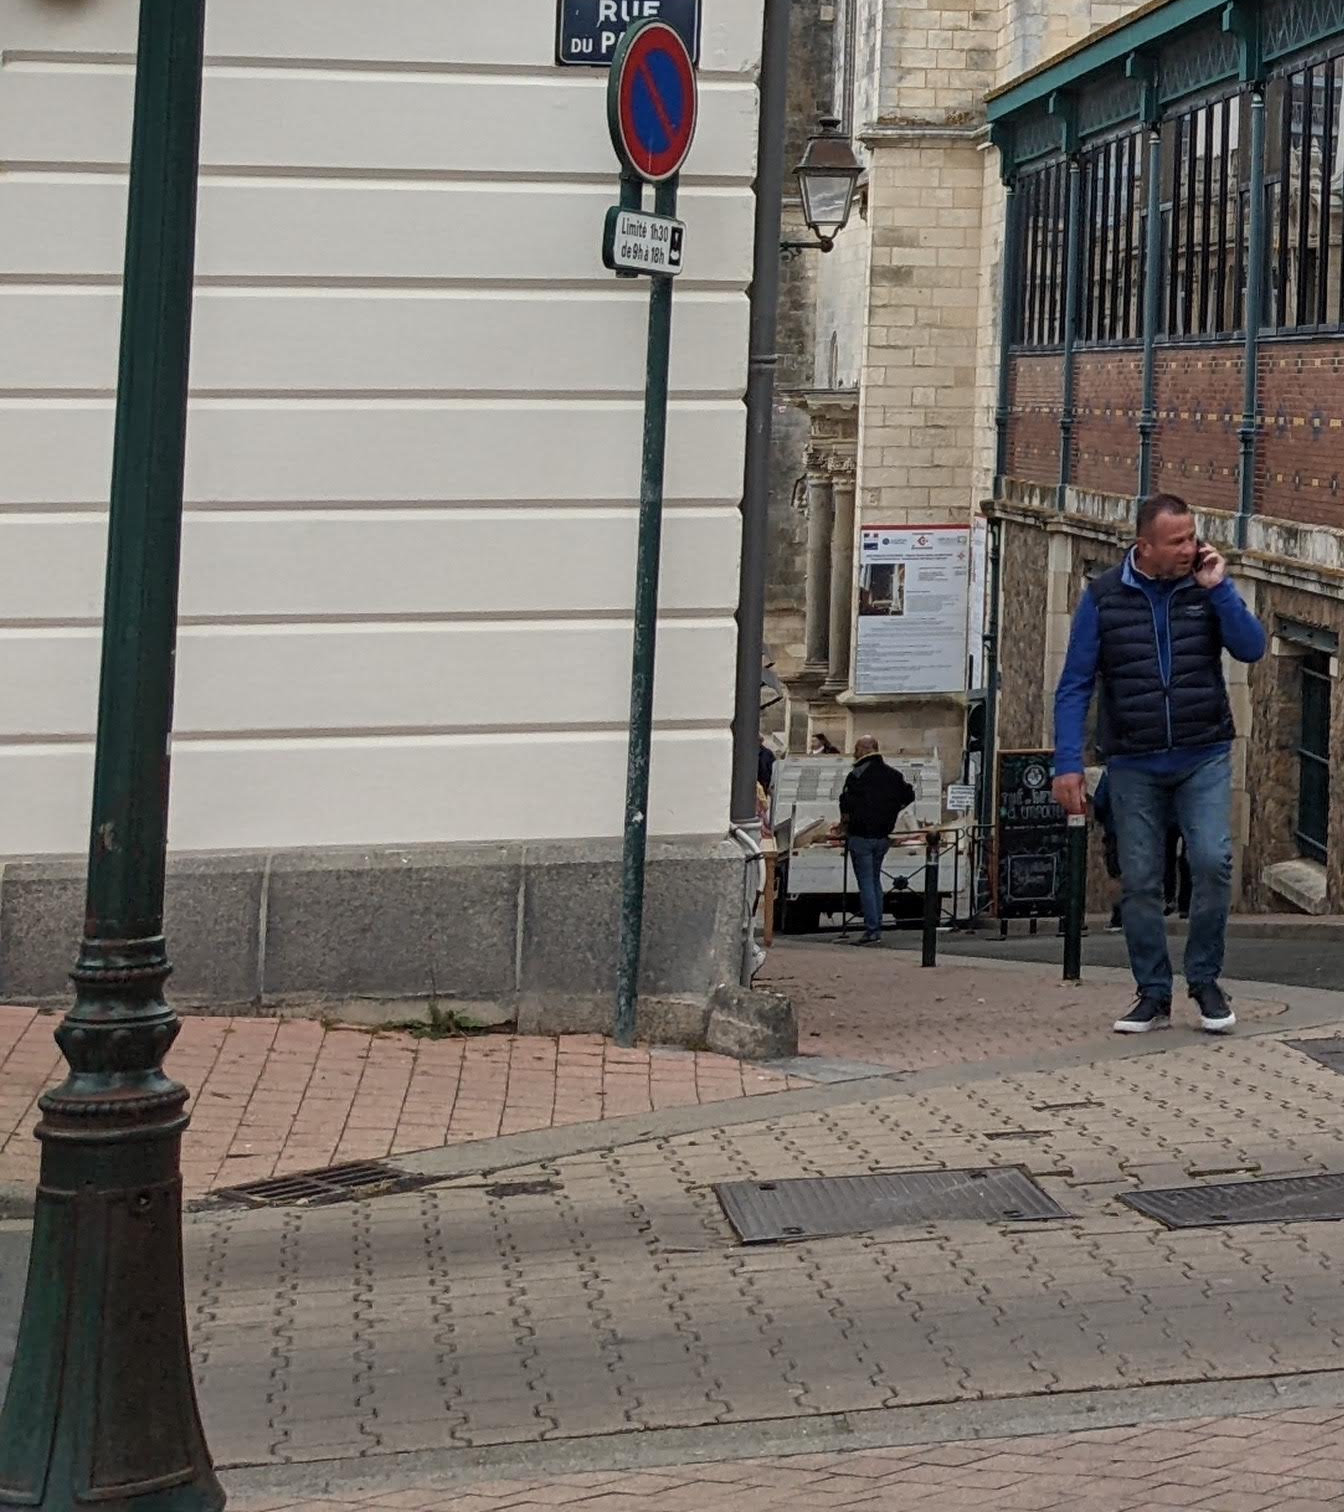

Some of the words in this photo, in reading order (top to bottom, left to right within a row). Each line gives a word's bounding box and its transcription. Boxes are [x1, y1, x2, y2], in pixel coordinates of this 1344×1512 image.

[599, 0, 661, 22] RUE
[570, 38, 593, 53] DU
[621, 217, 647, 238] Limité
[650, 224, 669, 242] 1h30
[621, 240, 632, 259] de
[651, 247, 665, 265] 18h
